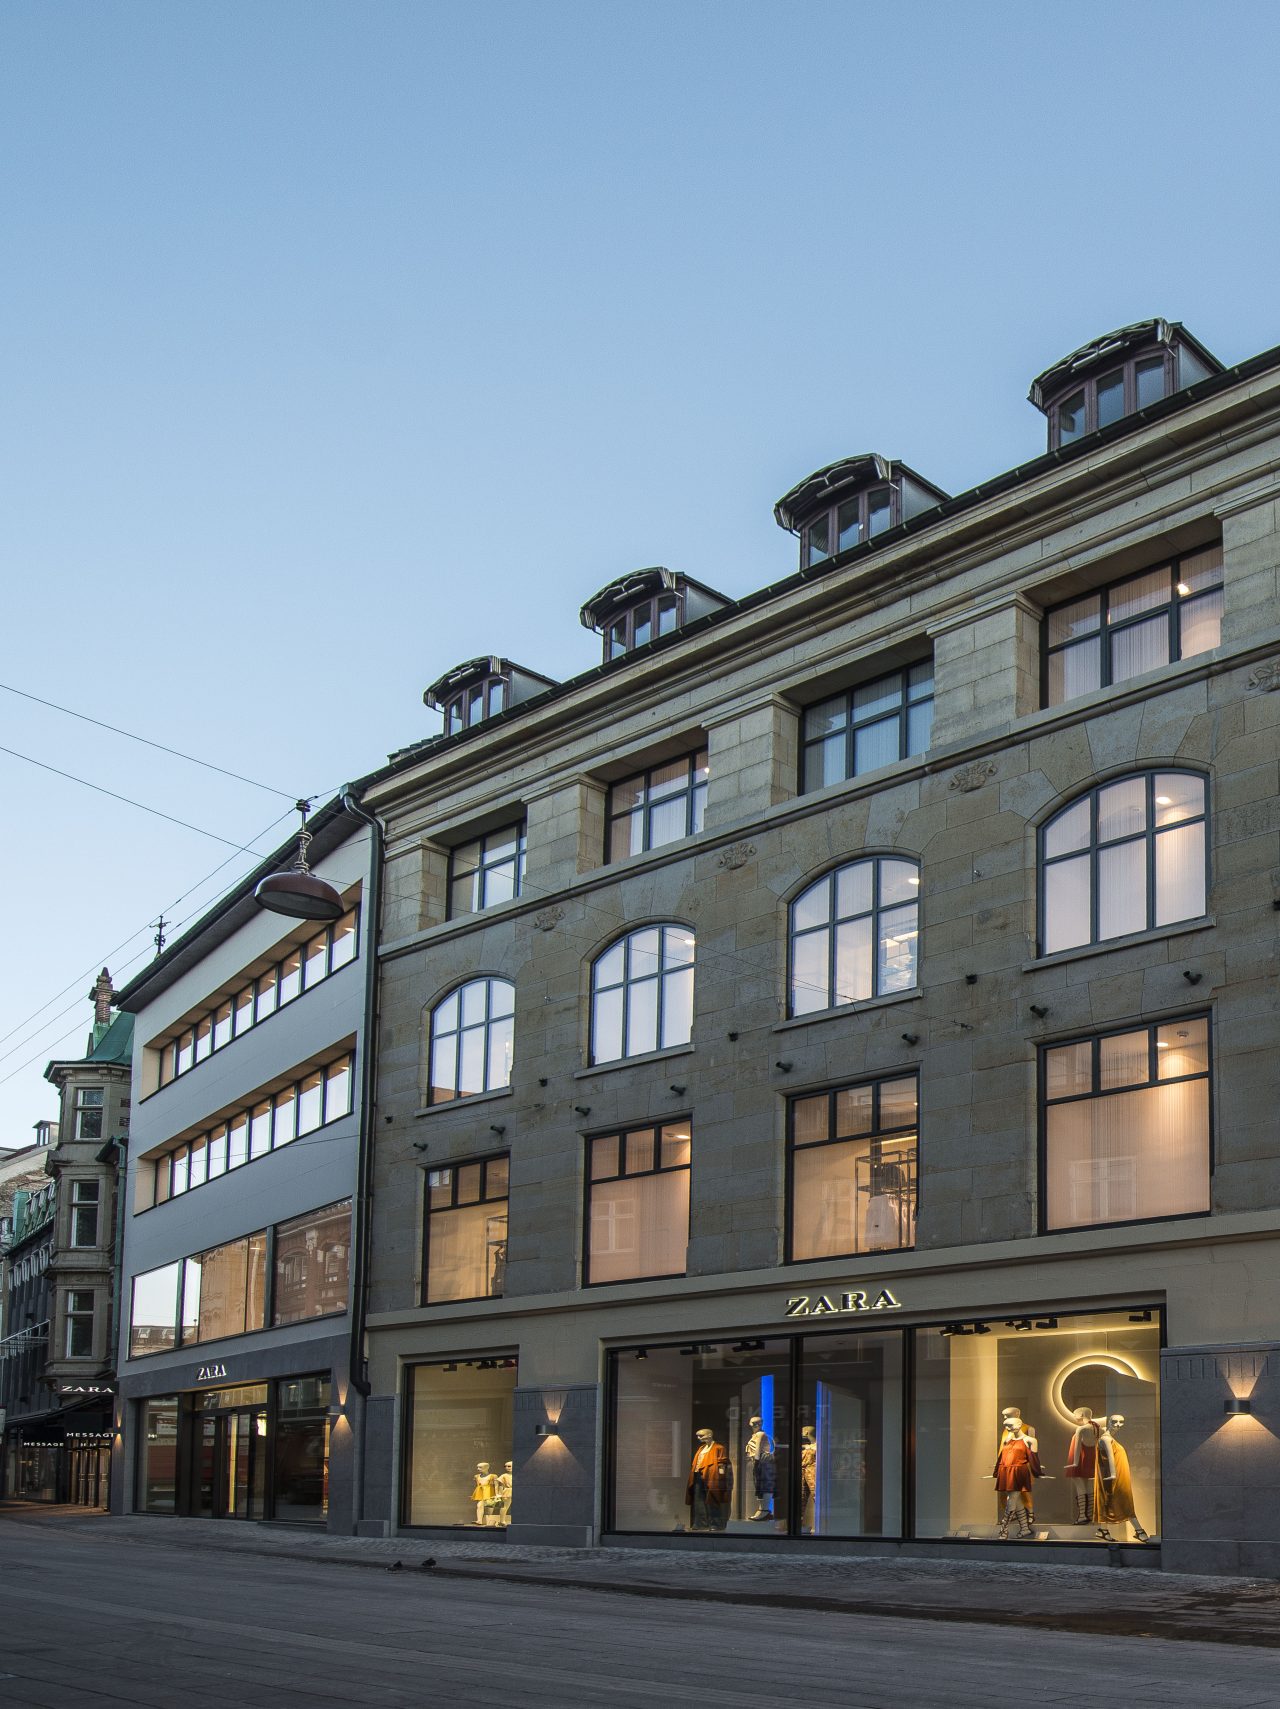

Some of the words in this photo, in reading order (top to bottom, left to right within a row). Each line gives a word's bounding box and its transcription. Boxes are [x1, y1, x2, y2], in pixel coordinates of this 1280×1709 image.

[783, 1289, 902, 1317] ZARA
[196, 1364, 227, 1381] ZARA
[61, 1385, 115, 1393] ZARA
